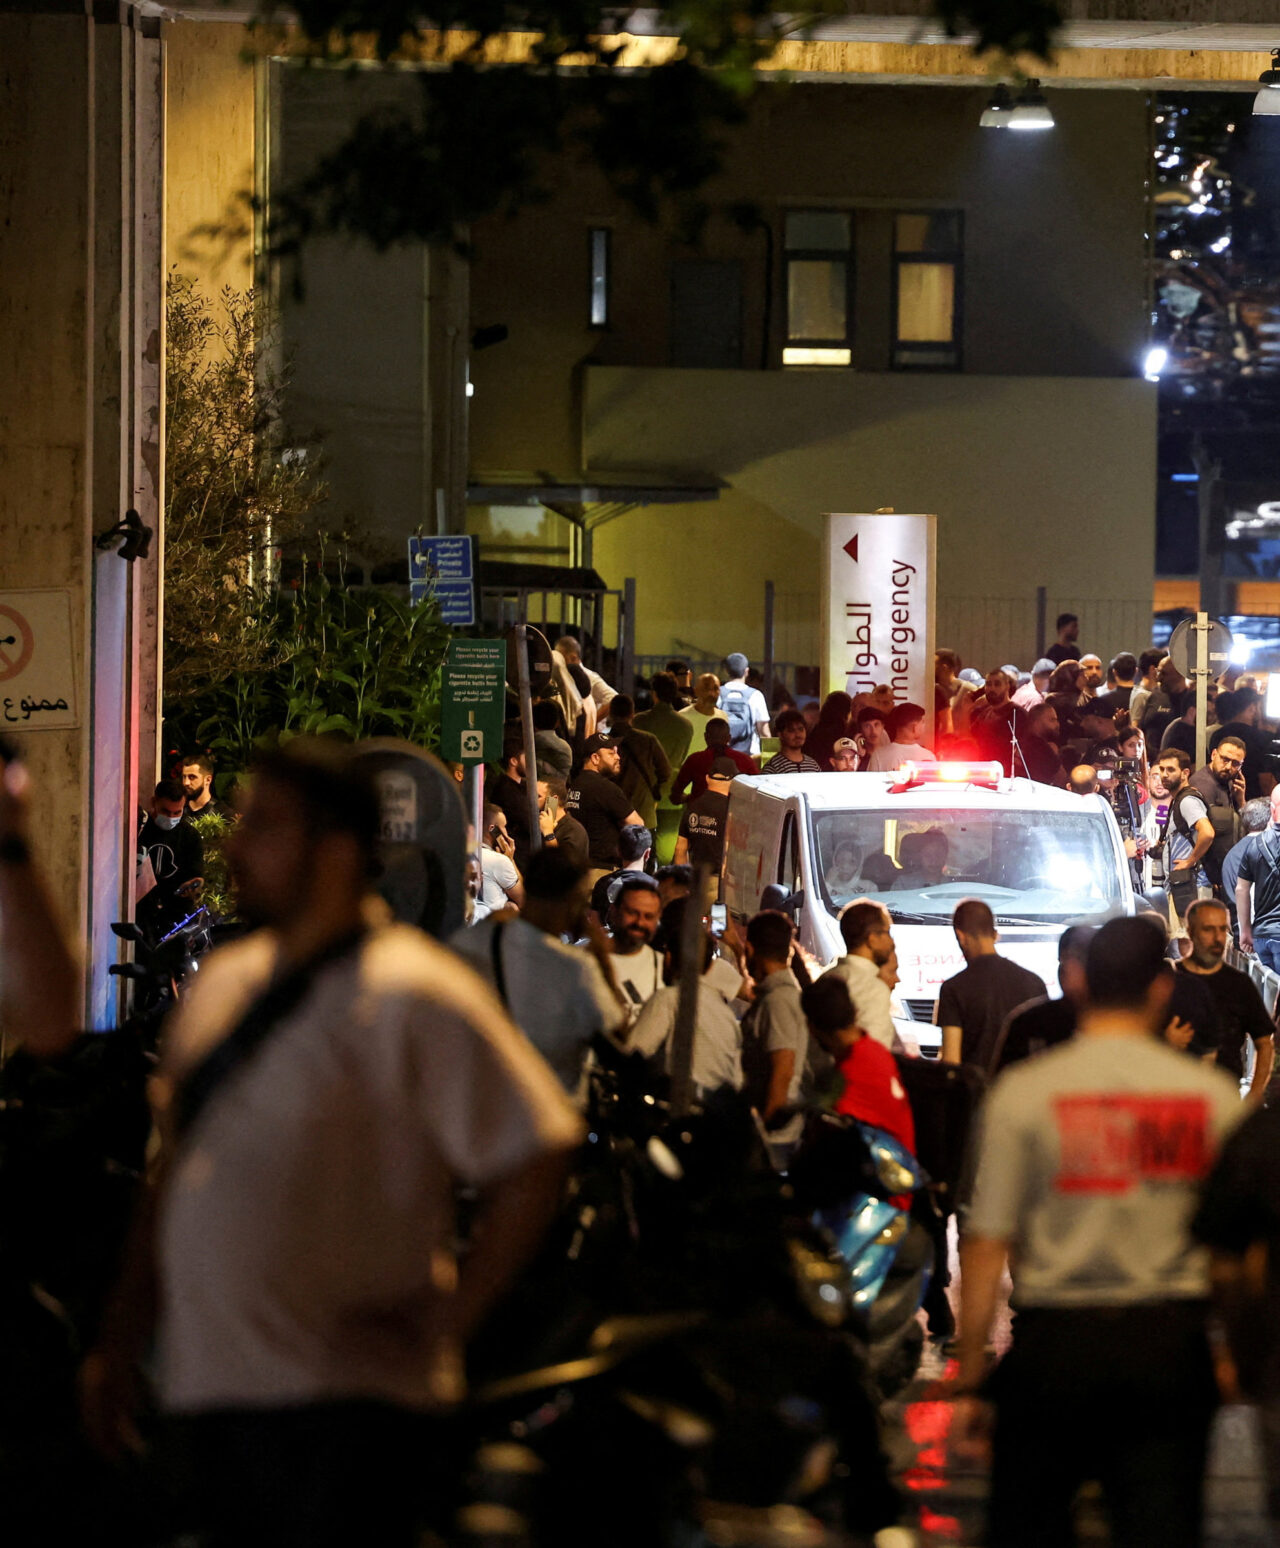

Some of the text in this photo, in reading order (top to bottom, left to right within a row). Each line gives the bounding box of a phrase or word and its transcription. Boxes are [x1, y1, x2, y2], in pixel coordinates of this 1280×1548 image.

[846, 603, 878, 694] الطوار
[891, 559, 916, 700] mergency
[3, 695, 69, 721] ممنوع
